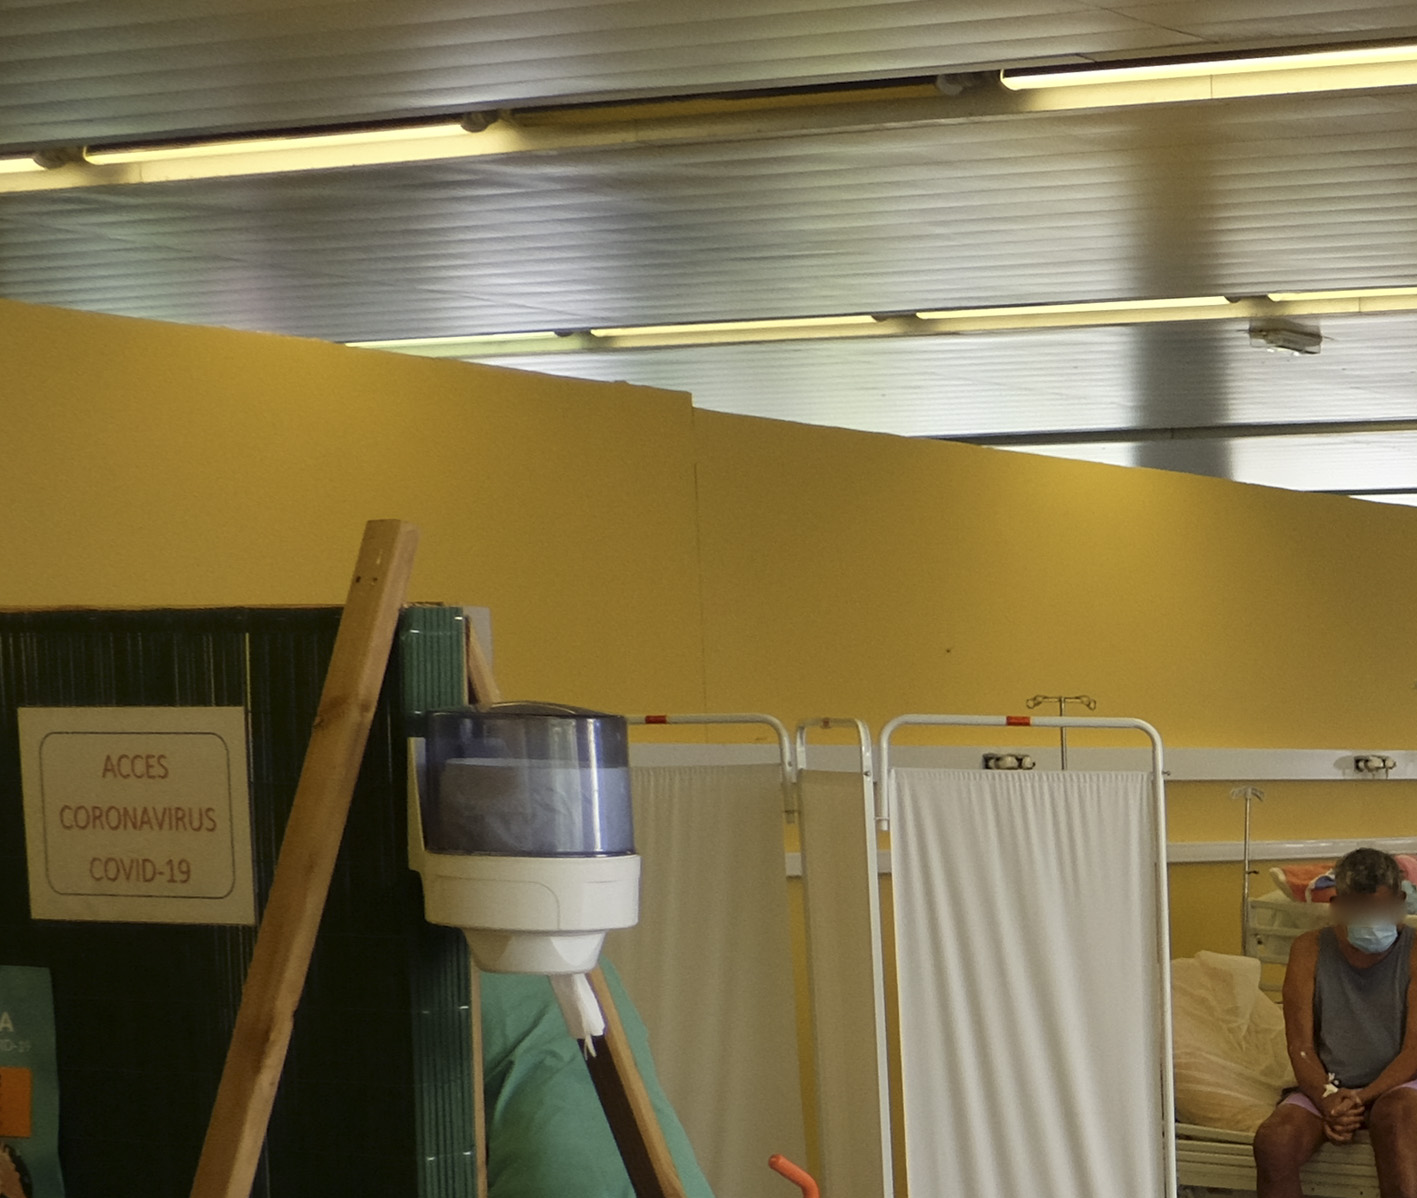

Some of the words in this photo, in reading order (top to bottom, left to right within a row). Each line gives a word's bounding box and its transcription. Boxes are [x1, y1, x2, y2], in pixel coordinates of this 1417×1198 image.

[102, 754, 169, 779] ACCES
[59, 805, 217, 832] CORONAVIRUS
[89, 857, 192, 883] COVID-19
